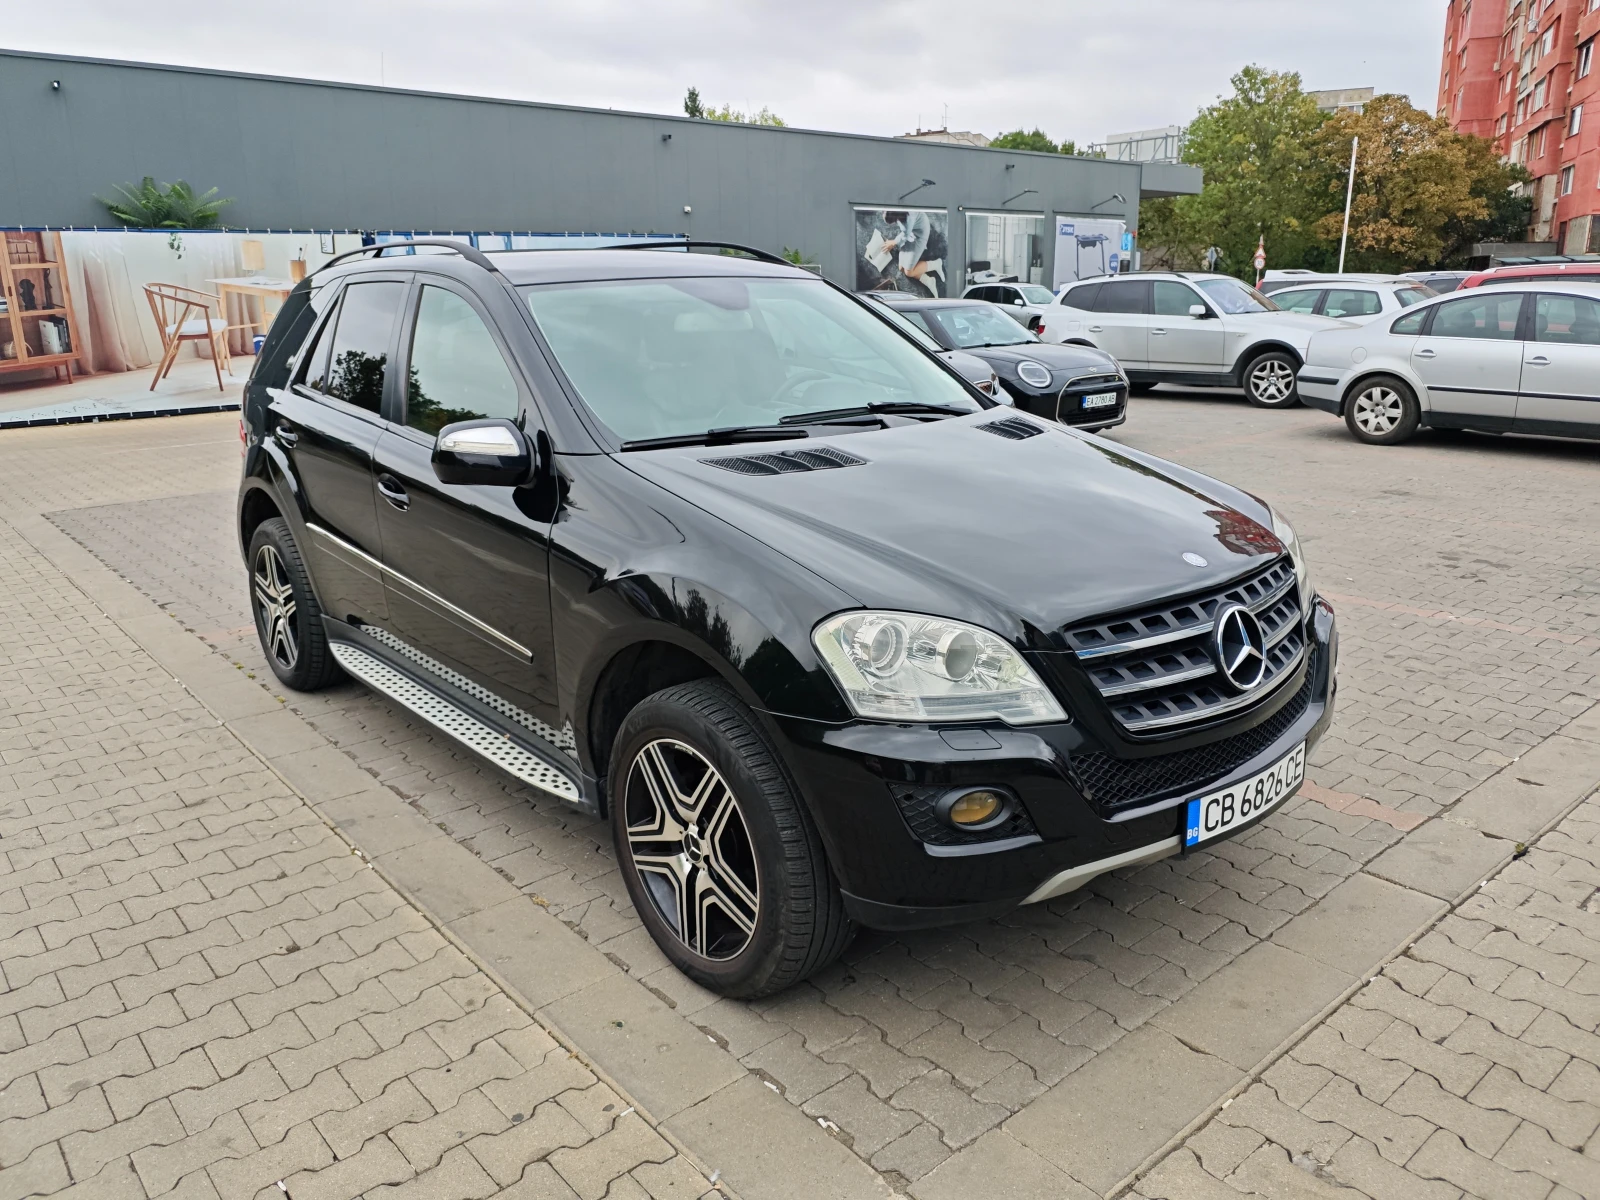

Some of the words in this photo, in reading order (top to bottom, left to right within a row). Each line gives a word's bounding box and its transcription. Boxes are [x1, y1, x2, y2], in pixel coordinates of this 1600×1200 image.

[1086, 397, 1094, 406] EA
[1204, 792, 1235, 833] CB
[1240, 764, 1283, 817] 6826
[1285, 747, 1303, 788] CE
[1186, 826, 1199, 840] BG
